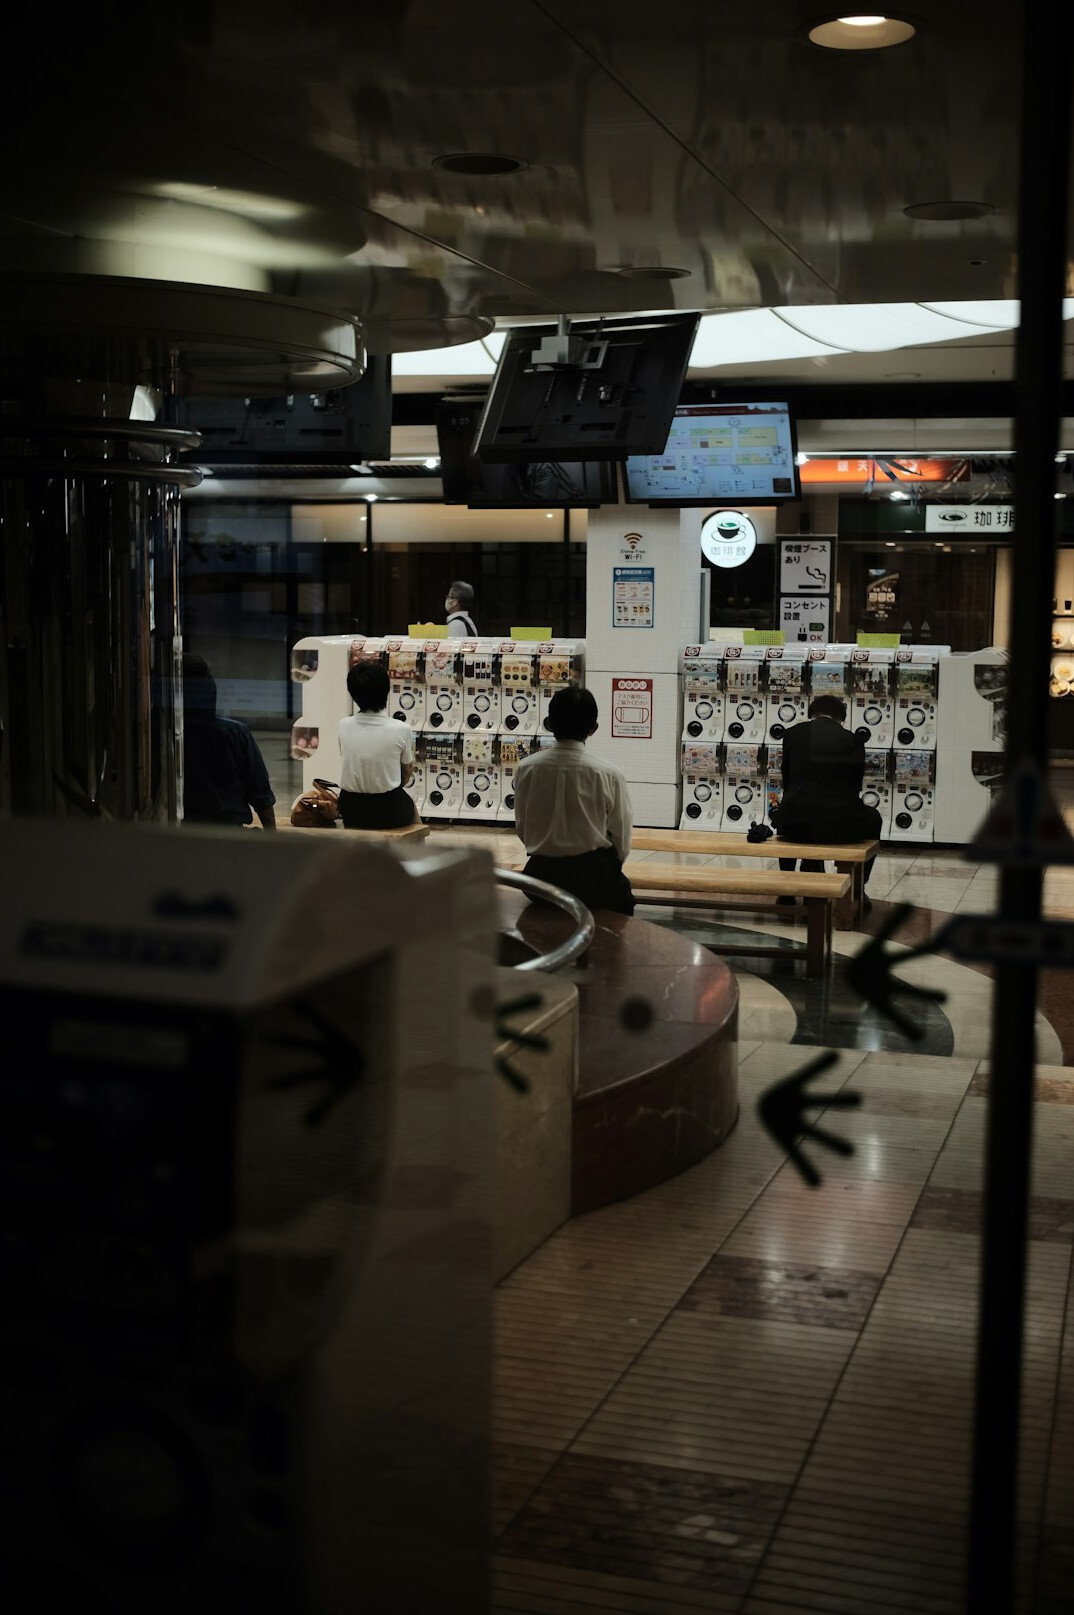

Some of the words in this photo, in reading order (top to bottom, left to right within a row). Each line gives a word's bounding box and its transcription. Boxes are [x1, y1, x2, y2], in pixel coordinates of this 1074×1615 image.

[784, 544, 827, 553] 喫煙ブース
[784, 555, 801, 564] あり
[784, 601, 826, 610] コンセント
[783, 612, 800, 621] 設置
[619, 681, 646, 689] おねがい
